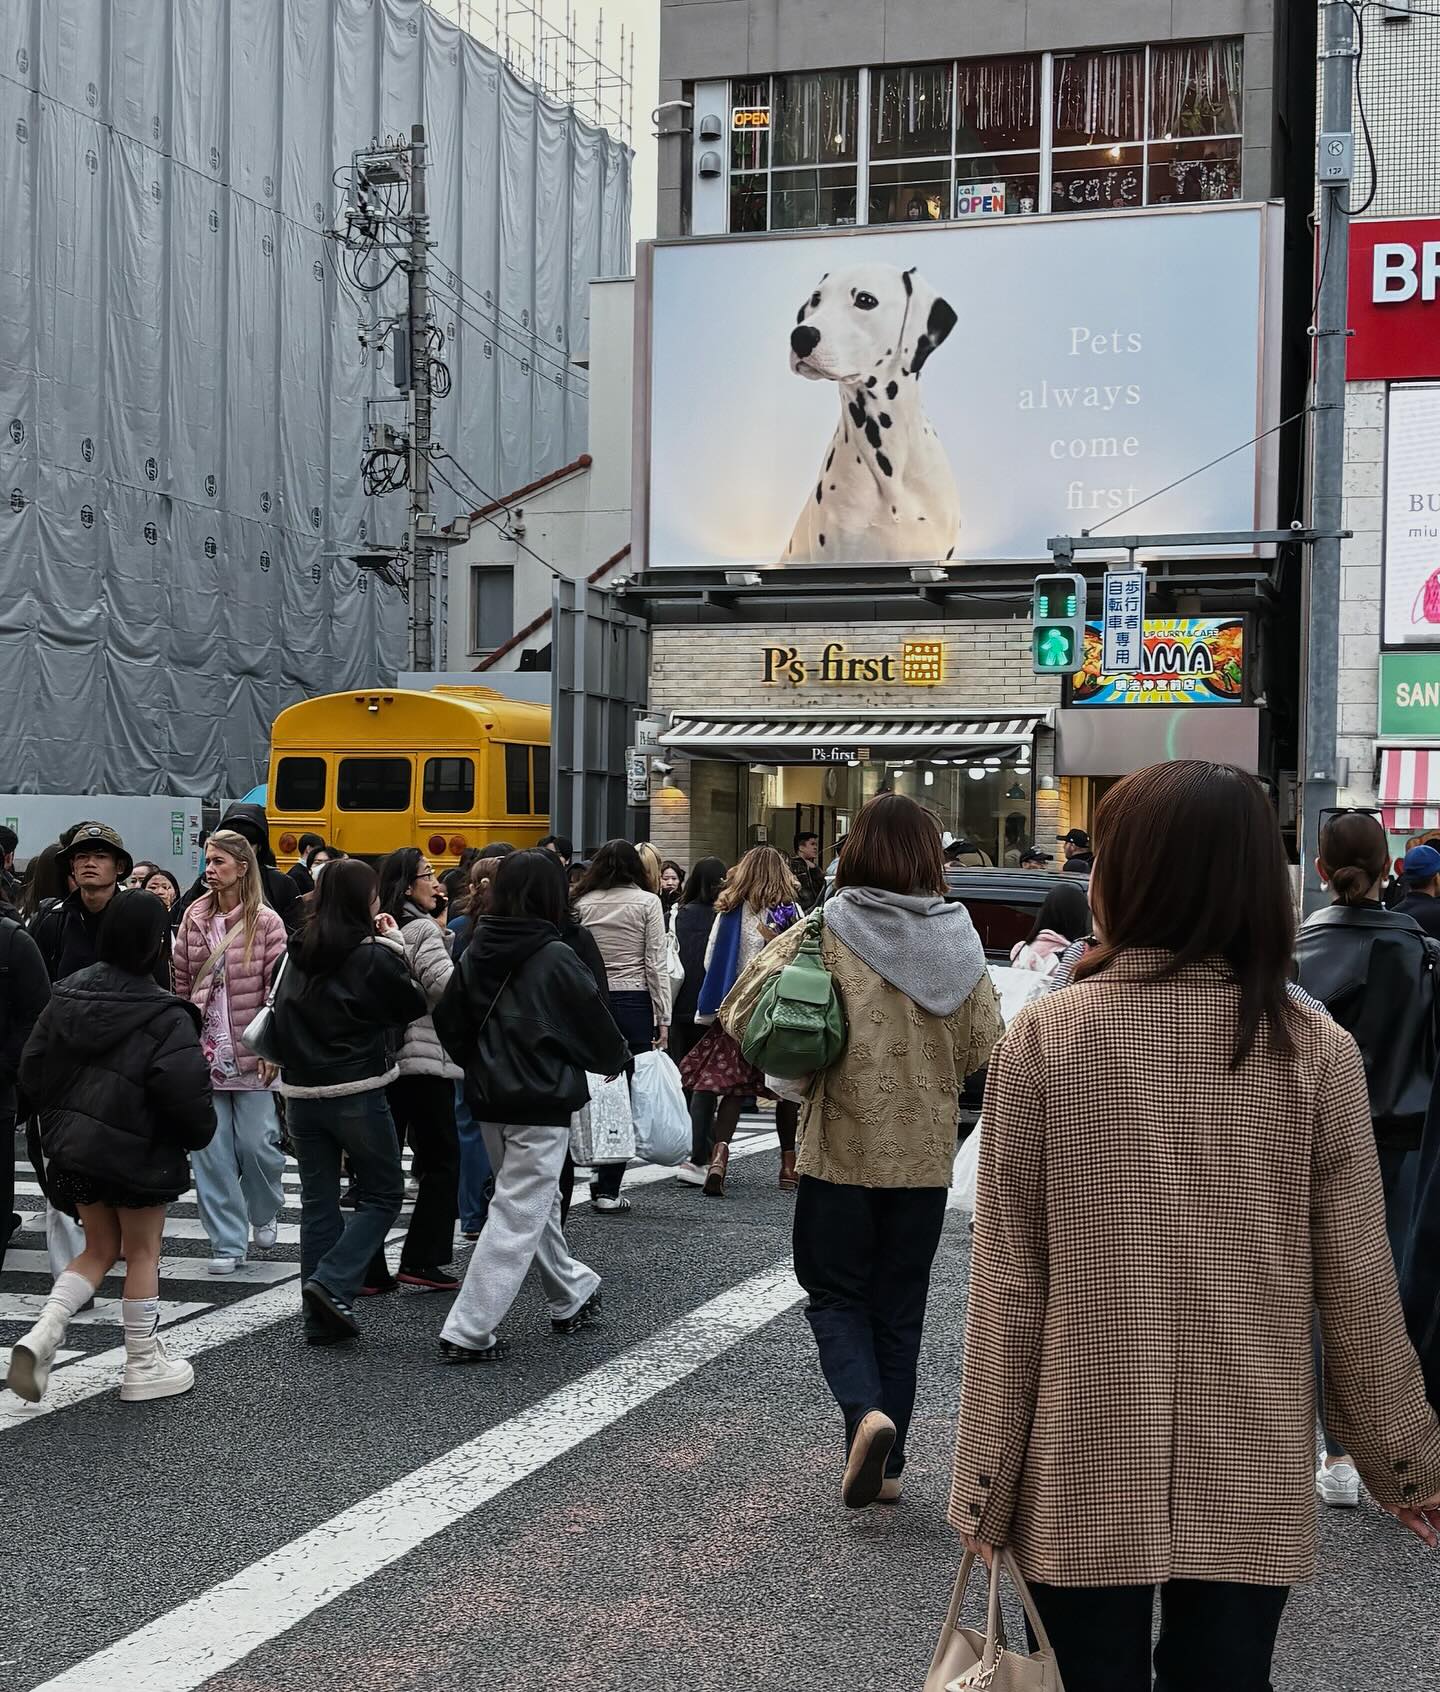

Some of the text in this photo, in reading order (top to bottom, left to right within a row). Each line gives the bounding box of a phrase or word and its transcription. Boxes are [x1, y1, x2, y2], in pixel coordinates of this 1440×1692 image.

[735, 112, 770, 125] OPEN
[959, 195, 1004, 214] OPEN
[1068, 326, 1142, 355] Pets
[1019, 380, 1141, 410] always
[1050, 435, 1139, 459] come
[1066, 480, 1140, 510] first
[1409, 524, 1438, 538] miu
[1108, 581, 1123, 631] 自転車
[1125, 580, 1140, 630] 歩行者
[1115, 632, 1130, 665] 専用
[1143, 641, 1214, 675] MA
